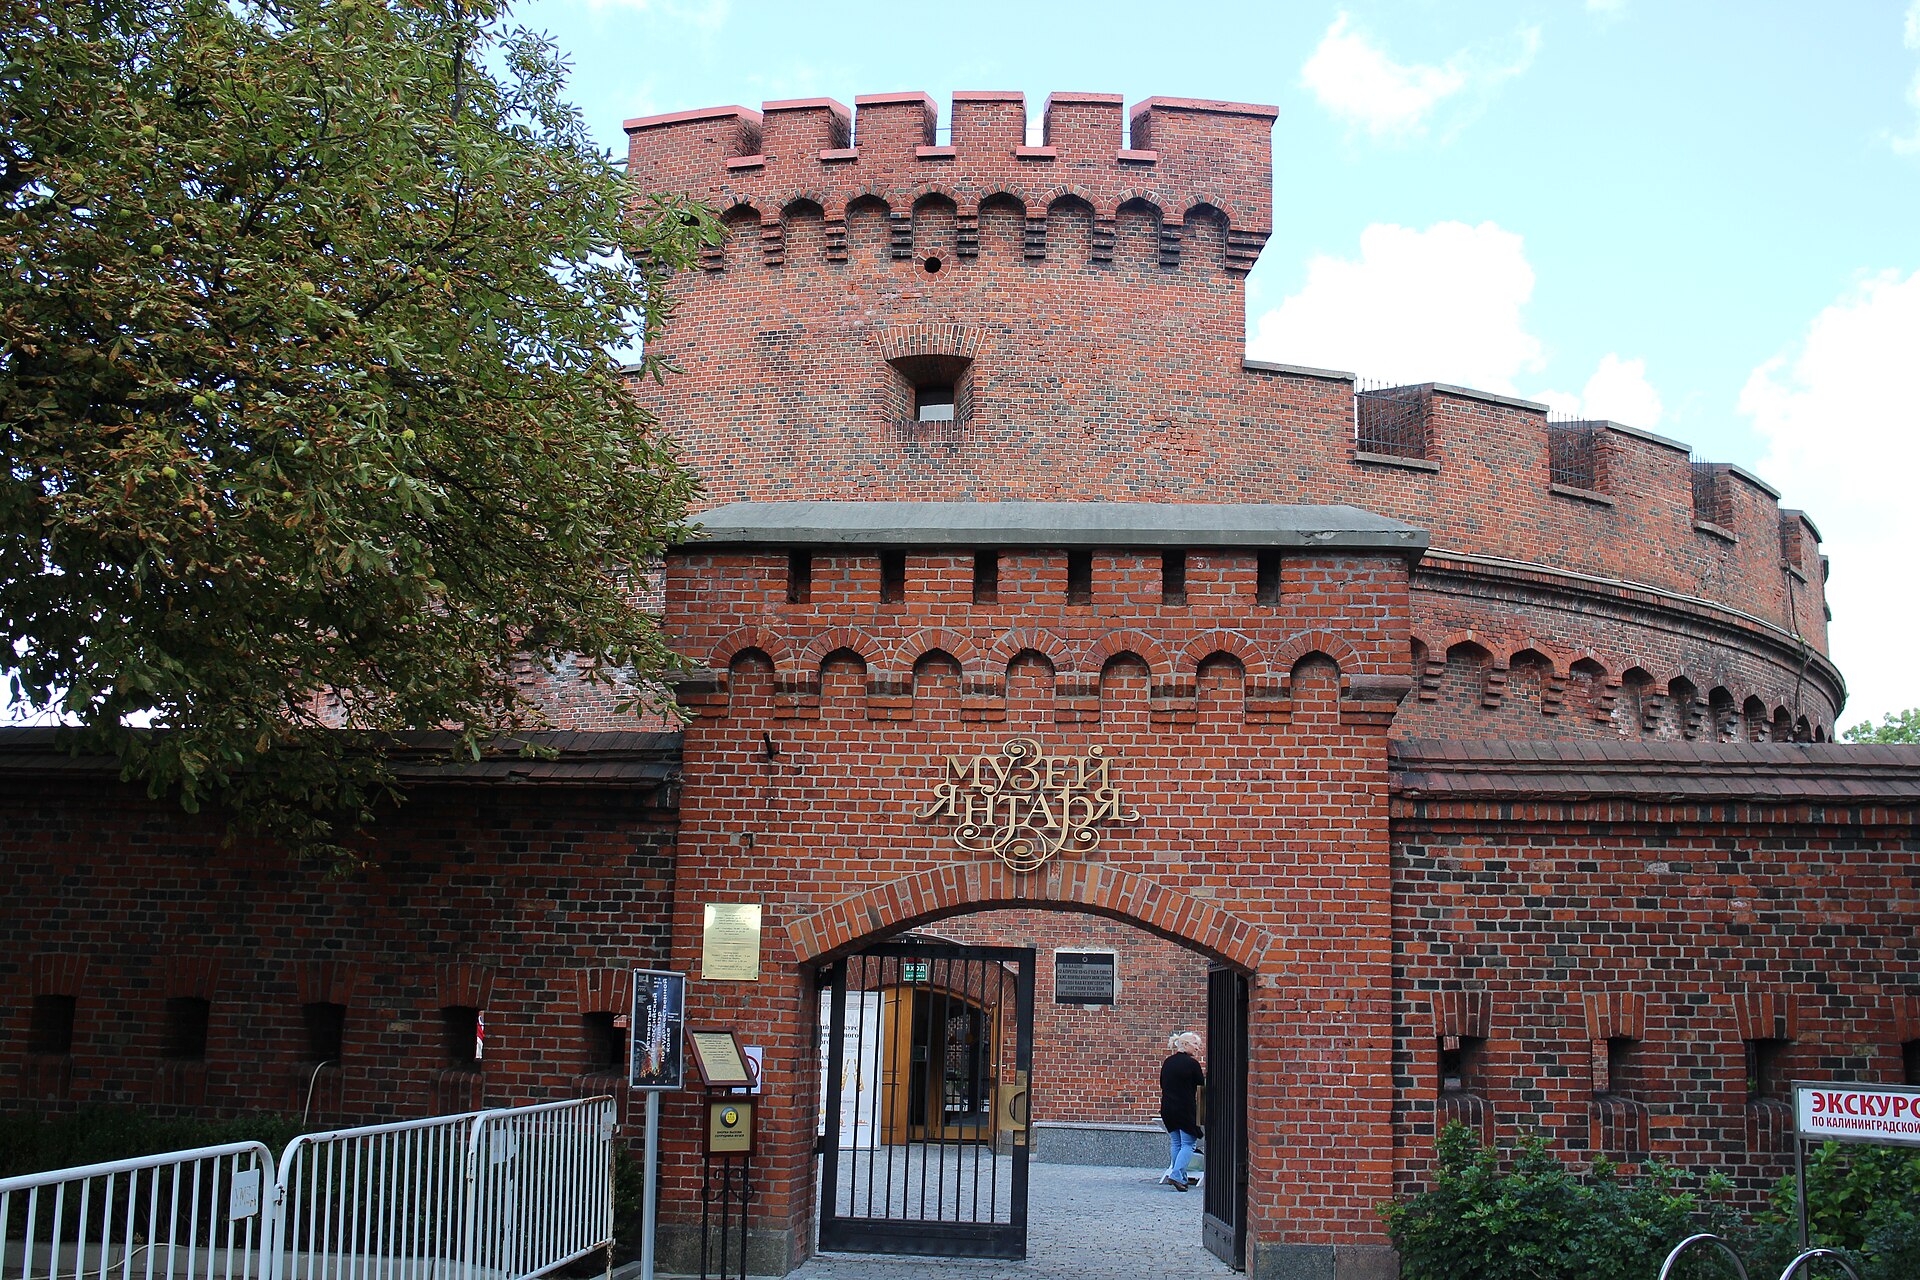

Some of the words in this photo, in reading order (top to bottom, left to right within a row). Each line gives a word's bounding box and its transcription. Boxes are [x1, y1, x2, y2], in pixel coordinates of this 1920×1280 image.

[943, 738, 1114, 795] МУЗЕЙ
[914, 779, 1140, 871] ЯНТАРЯ
[1811, 1116, 1824, 1127] ПО
[1826, 1117, 1920, 1134] КАЛИНИНГРАДСКОЙ
